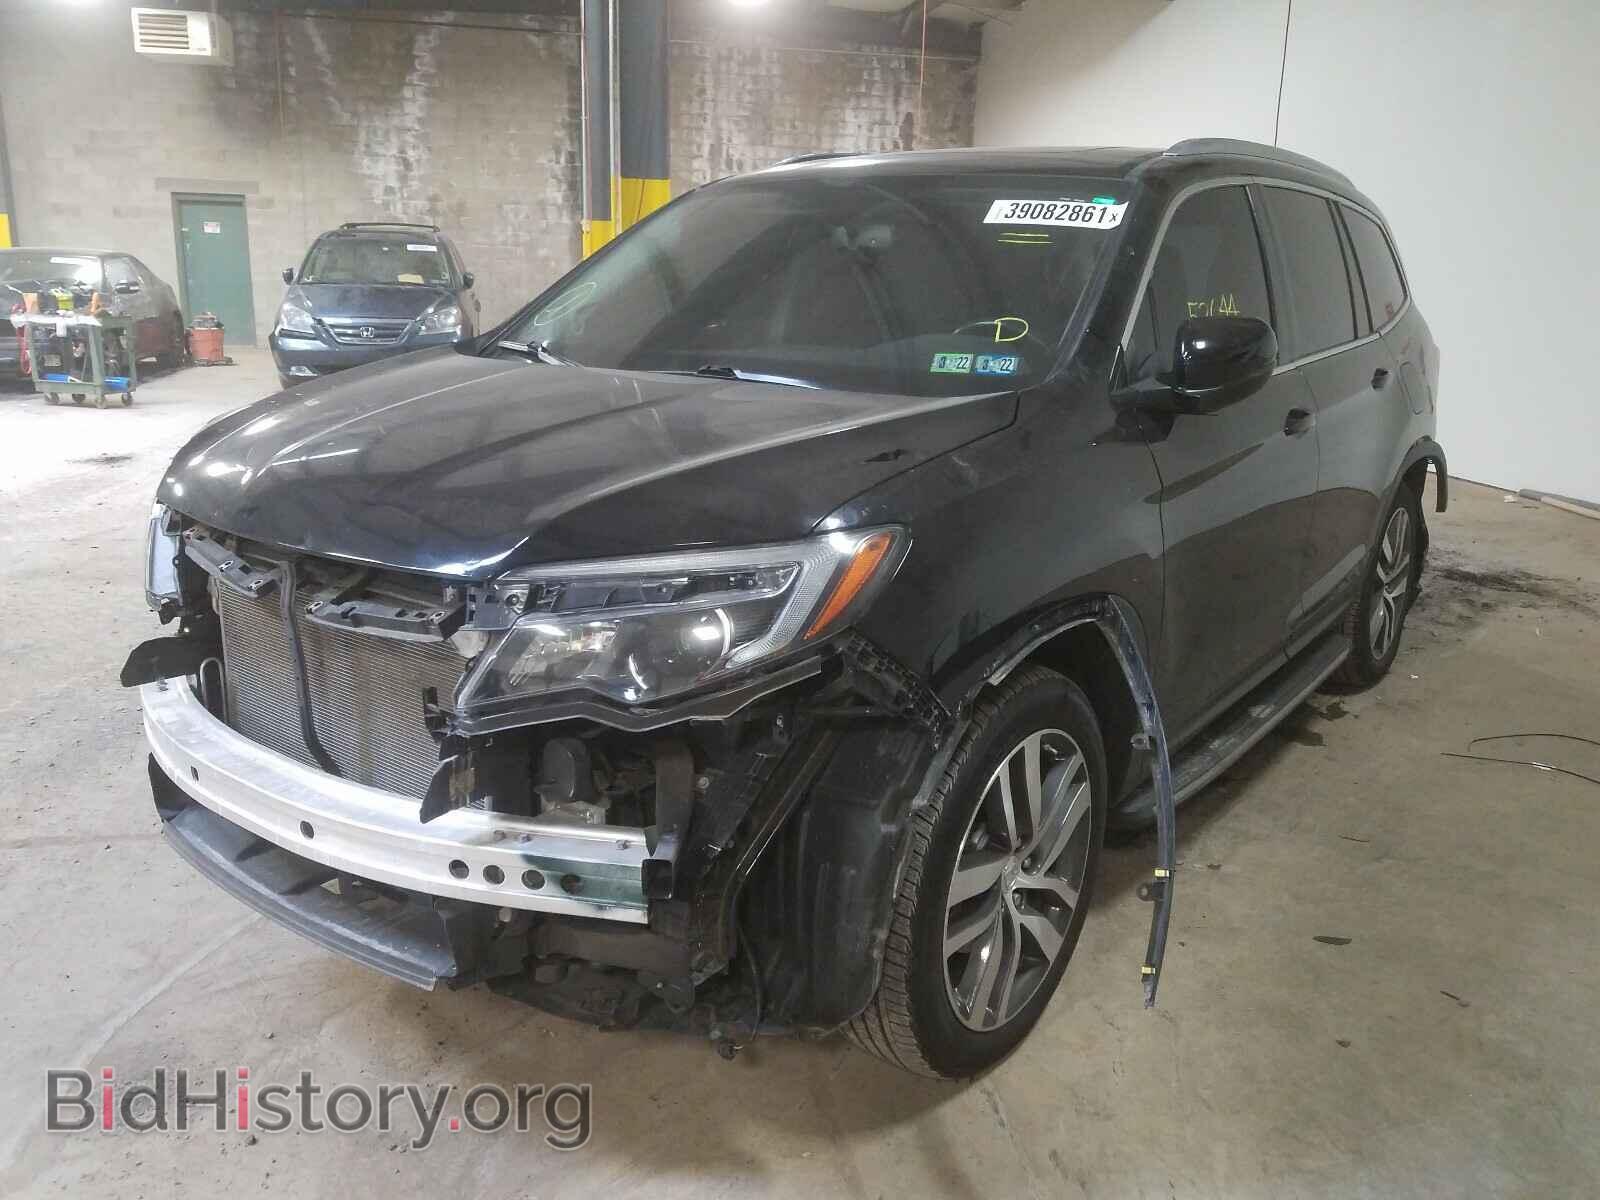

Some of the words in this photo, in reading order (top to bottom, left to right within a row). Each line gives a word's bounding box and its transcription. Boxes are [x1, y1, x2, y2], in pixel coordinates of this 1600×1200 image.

[1004, 202, 1108, 224] 39082861
[956, 356, 969, 370] 22
[1000, 358, 1014, 371] 22
